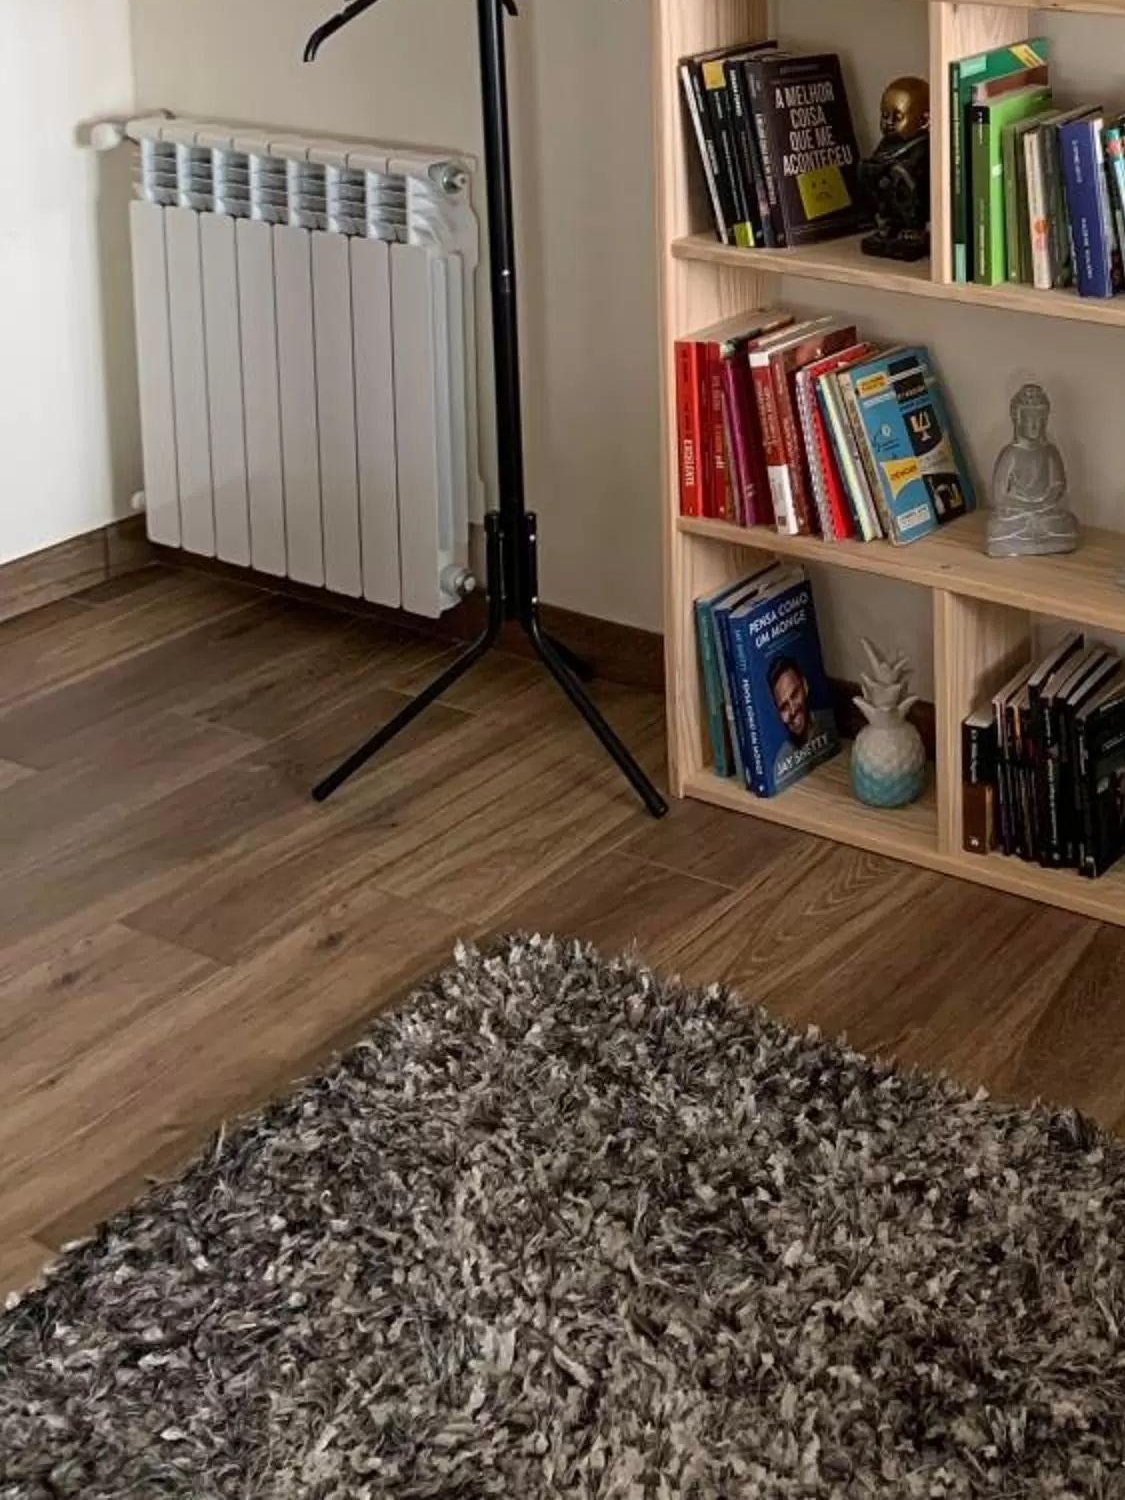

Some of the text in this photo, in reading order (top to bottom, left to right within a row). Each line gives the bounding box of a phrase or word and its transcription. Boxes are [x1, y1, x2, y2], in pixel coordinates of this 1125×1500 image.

[775, 81, 834, 108] A MELHOR
[789, 105, 827, 129] COISA
[789, 125, 835, 151] QUE ME
[783, 144, 853, 176] ACONTECEU
[749, 591, 808, 636] PENSA COMO
[755, 609, 808, 649] UM MONGE
[776, 754, 793, 776] JAY
